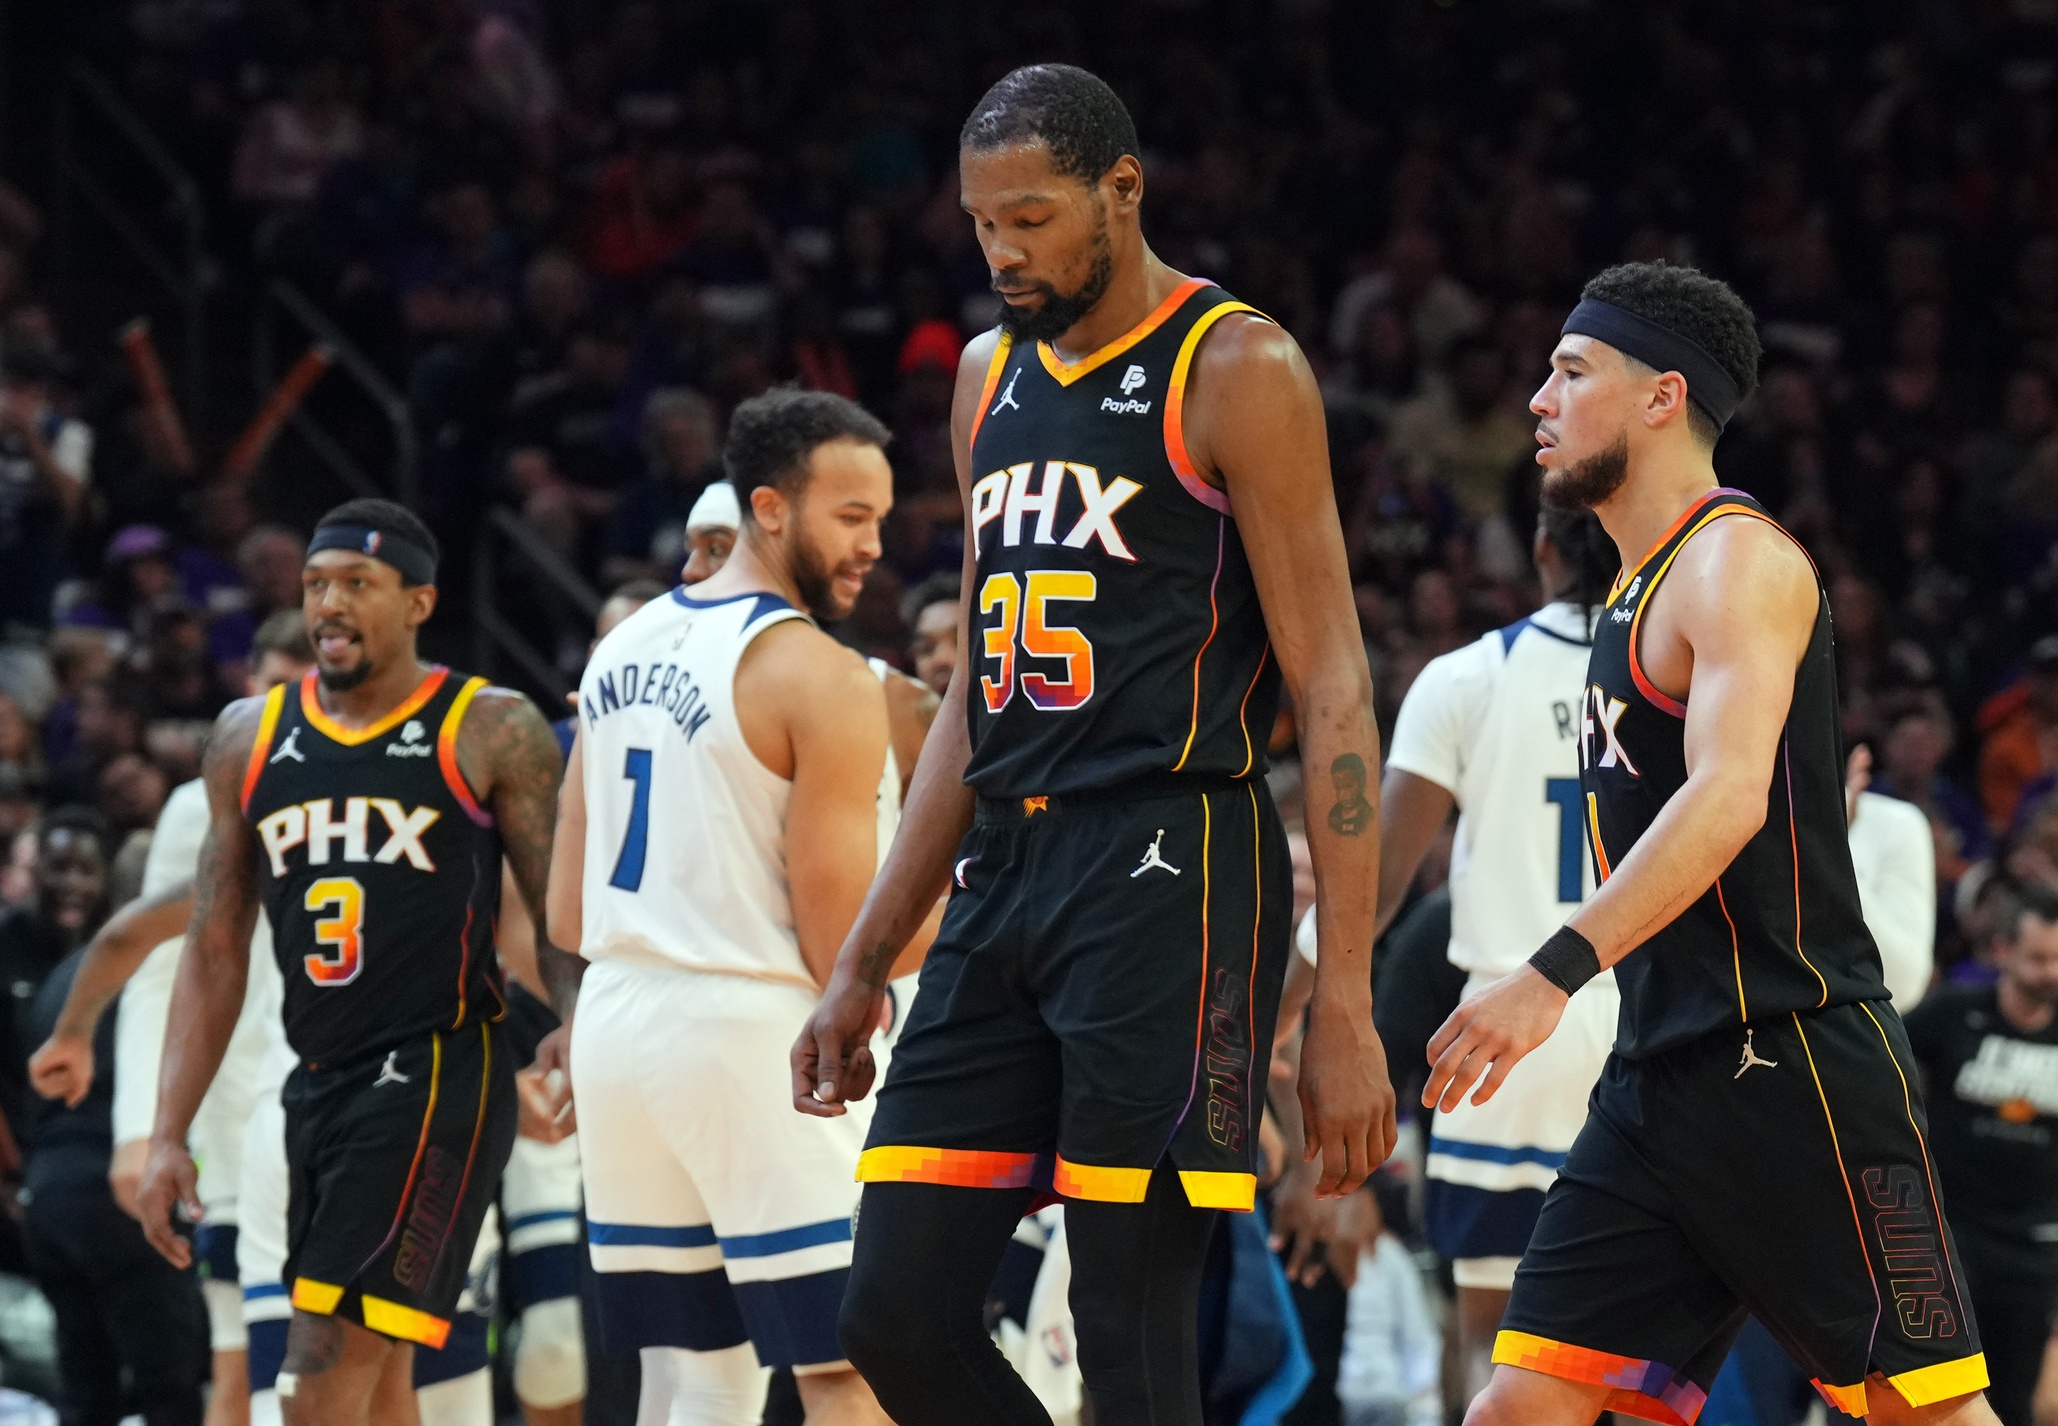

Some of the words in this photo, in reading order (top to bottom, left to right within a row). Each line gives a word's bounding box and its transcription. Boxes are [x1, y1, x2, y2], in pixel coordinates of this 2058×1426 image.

[1100, 397, 1152, 415] PayPal
[971, 461, 1144, 562] PHX
[980, 570, 1097, 713] 35
[1610, 607, 1635, 623] PayPal
[385, 742, 433, 758] PayPal
[584, 662, 711, 745] ANDERSON
[1580, 682, 1641, 777] HX
[256, 796, 442, 878] PHX
[607, 747, 652, 893] 1
[304, 876, 365, 987] 3
[1206, 967, 1247, 1153] SUNS
[393, 1143, 462, 1294] SUNS
[1861, 1164, 1957, 1339] SUNS
